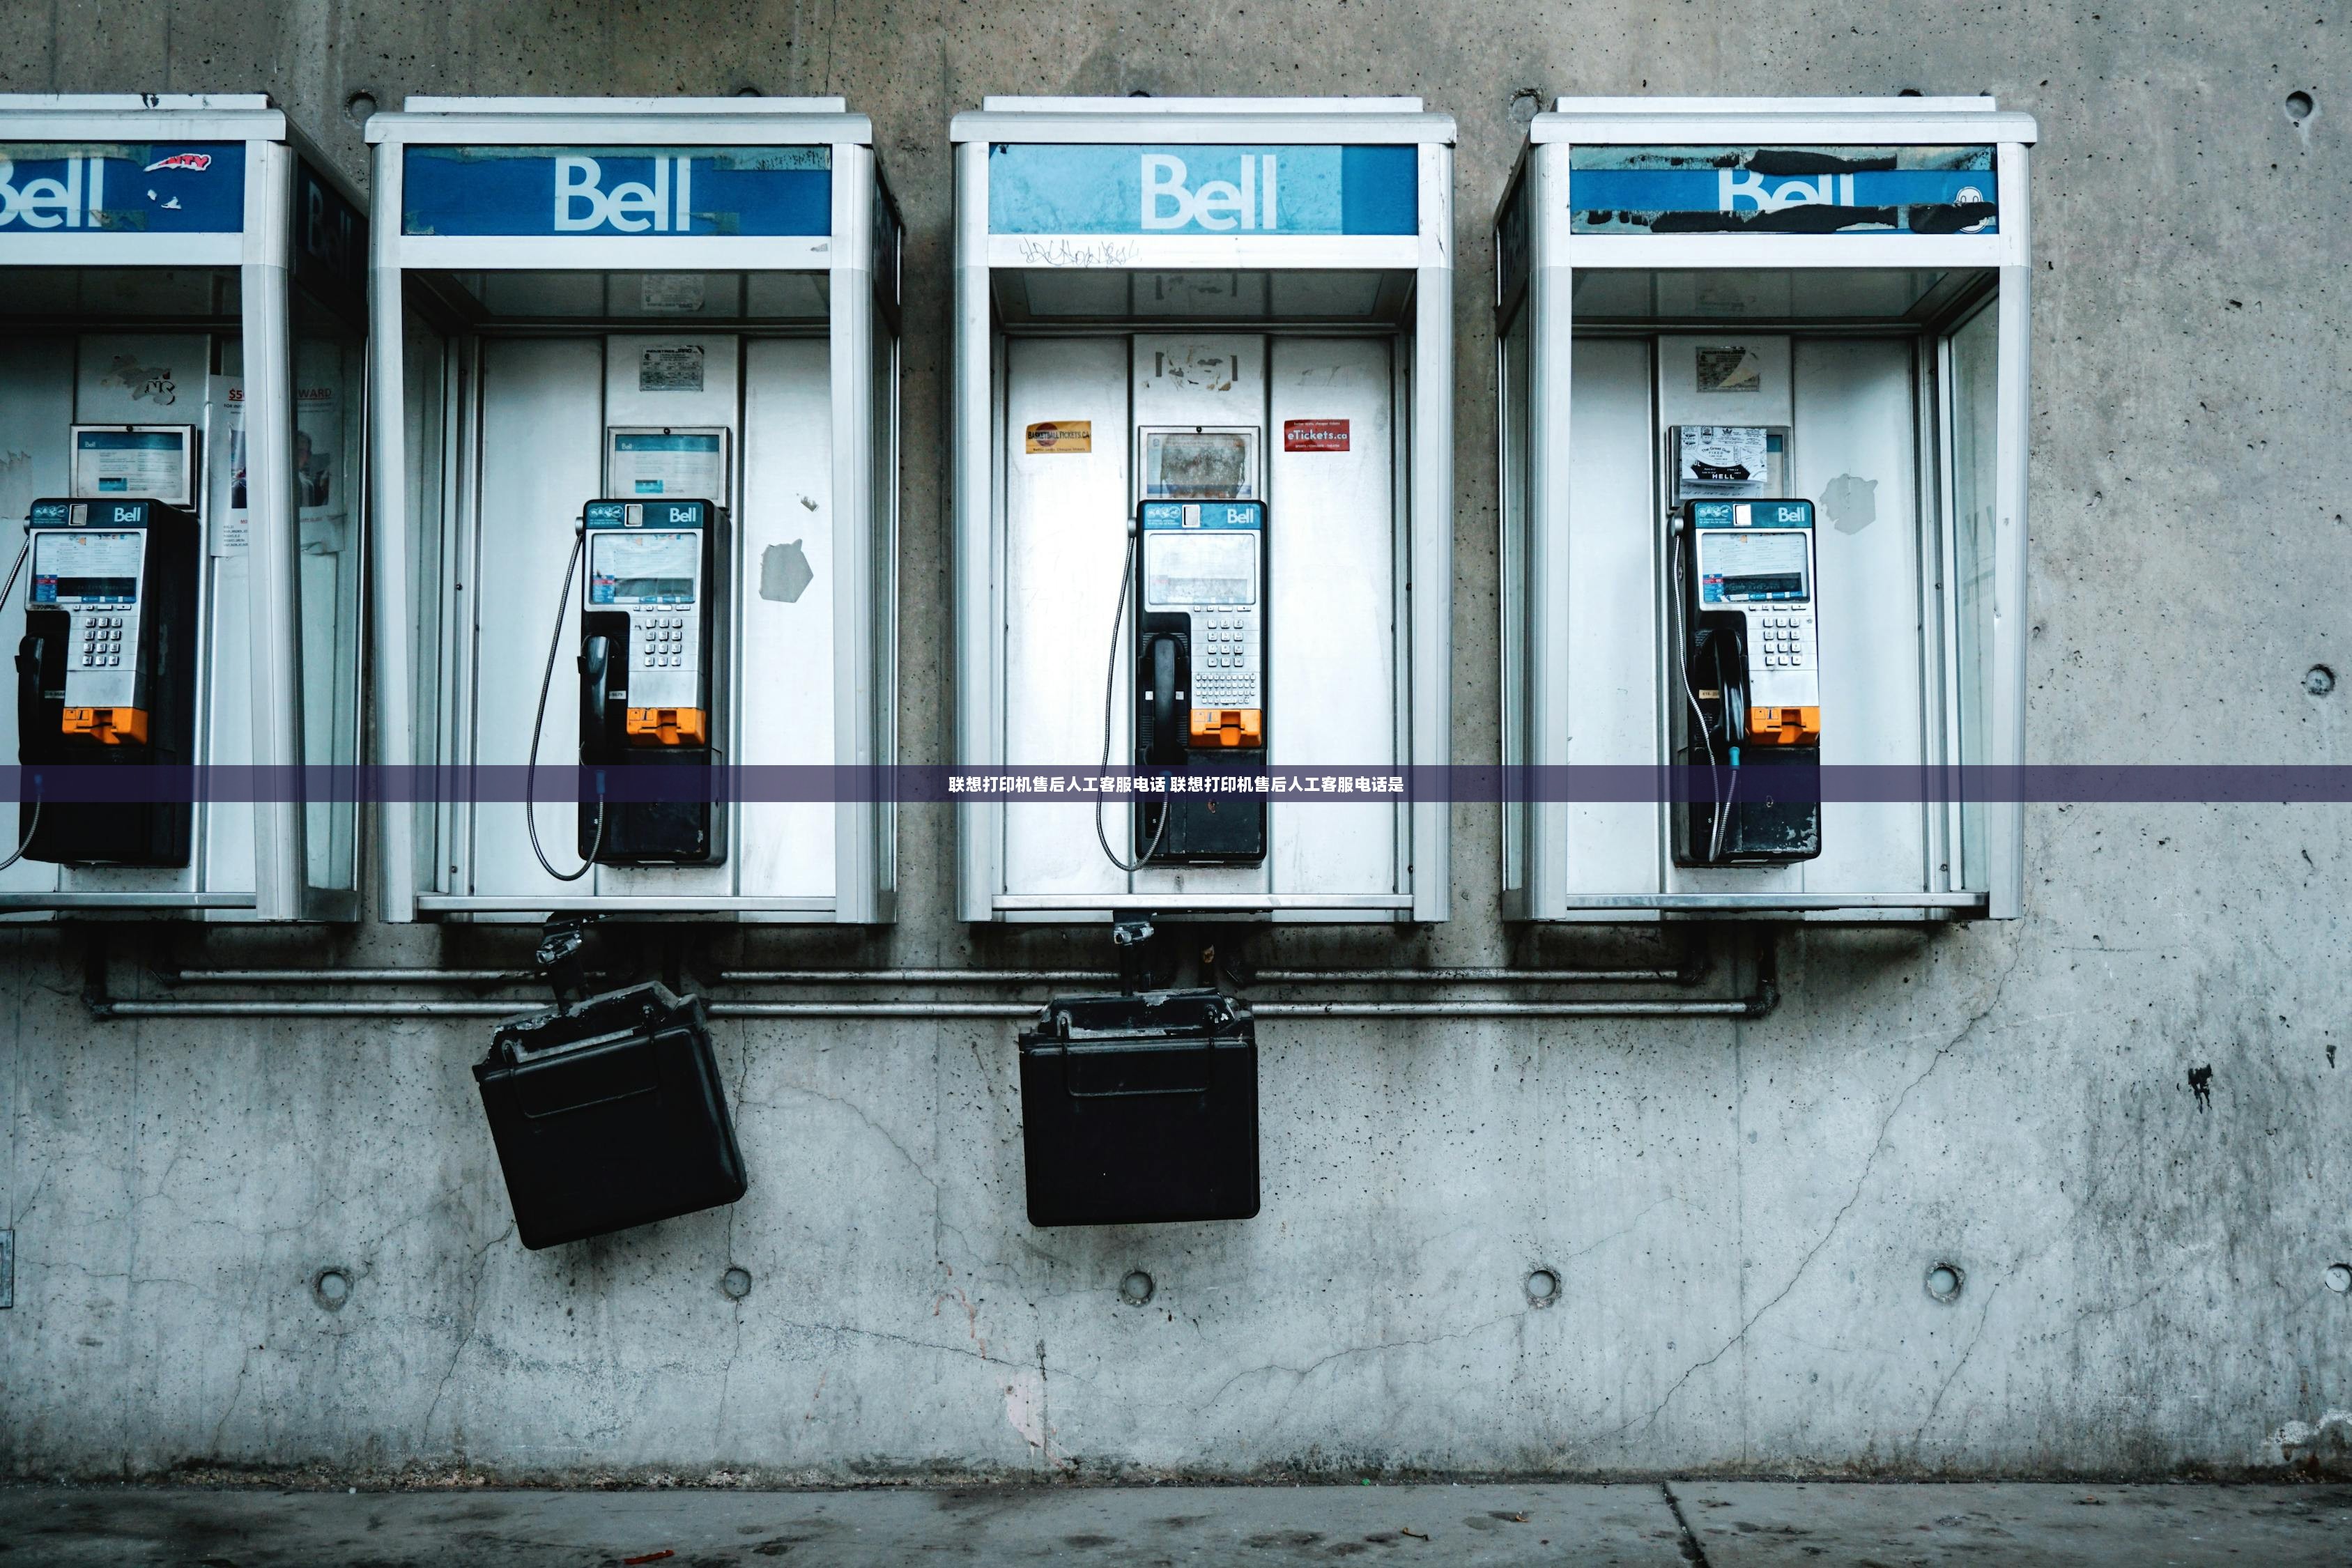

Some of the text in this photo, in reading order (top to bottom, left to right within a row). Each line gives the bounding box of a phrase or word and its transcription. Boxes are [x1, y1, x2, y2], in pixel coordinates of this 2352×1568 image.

[554, 155, 691, 232] Bell
[1141, 154, 1277, 230] Bell
[229, 387, 331, 402] $5 WARD
[1288, 429, 1347, 440] eTickets.ca
[114, 507, 141, 522] Bell
[670, 507, 696, 523] Bell
[1227, 509, 1254, 523] Bell
[1778, 507, 1805, 522] Bell
